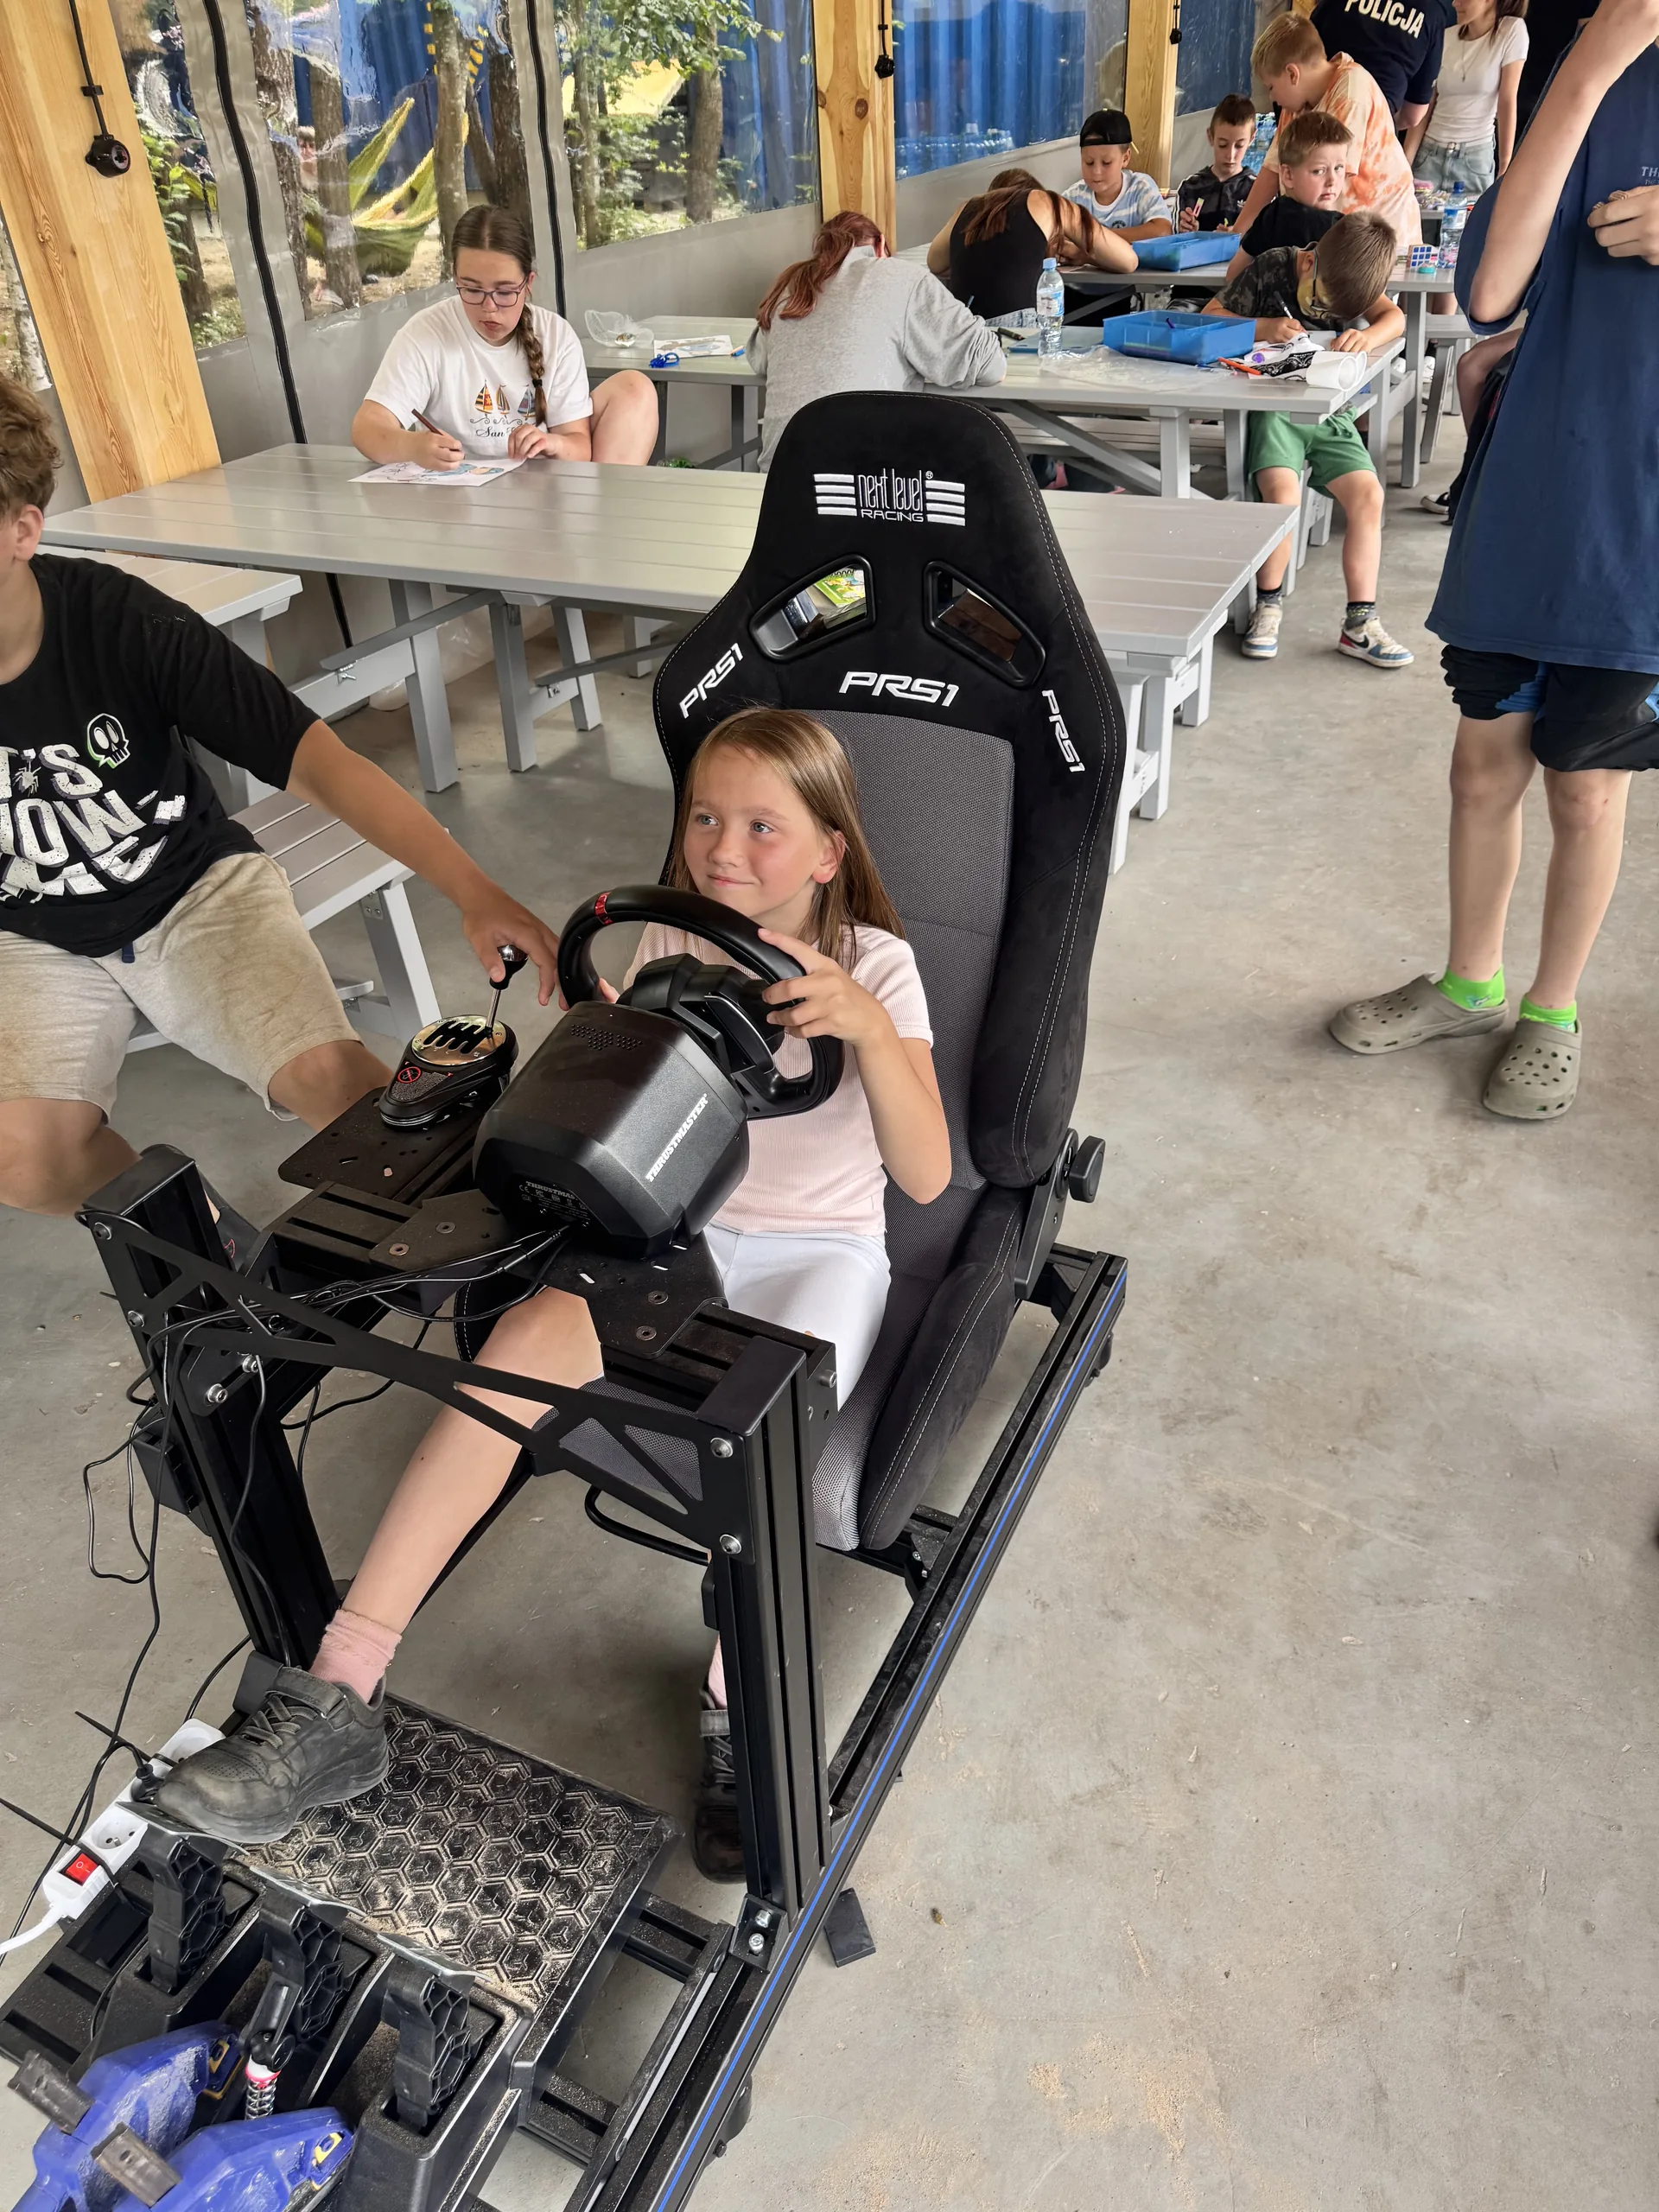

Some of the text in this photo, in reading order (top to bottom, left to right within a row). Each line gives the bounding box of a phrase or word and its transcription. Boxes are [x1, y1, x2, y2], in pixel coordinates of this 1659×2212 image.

[1642, 166, 1659, 177] TH
[858, 467, 889, 509] next
[861, 509, 924, 522] RACING
[679, 643, 743, 719] PRS1
[838, 671, 959, 707] PRS1
[1042, 690, 1085, 772] PRS1
[0, 788, 147, 868] OW
[645, 1093, 709, 1182] THRUSTMASTER
